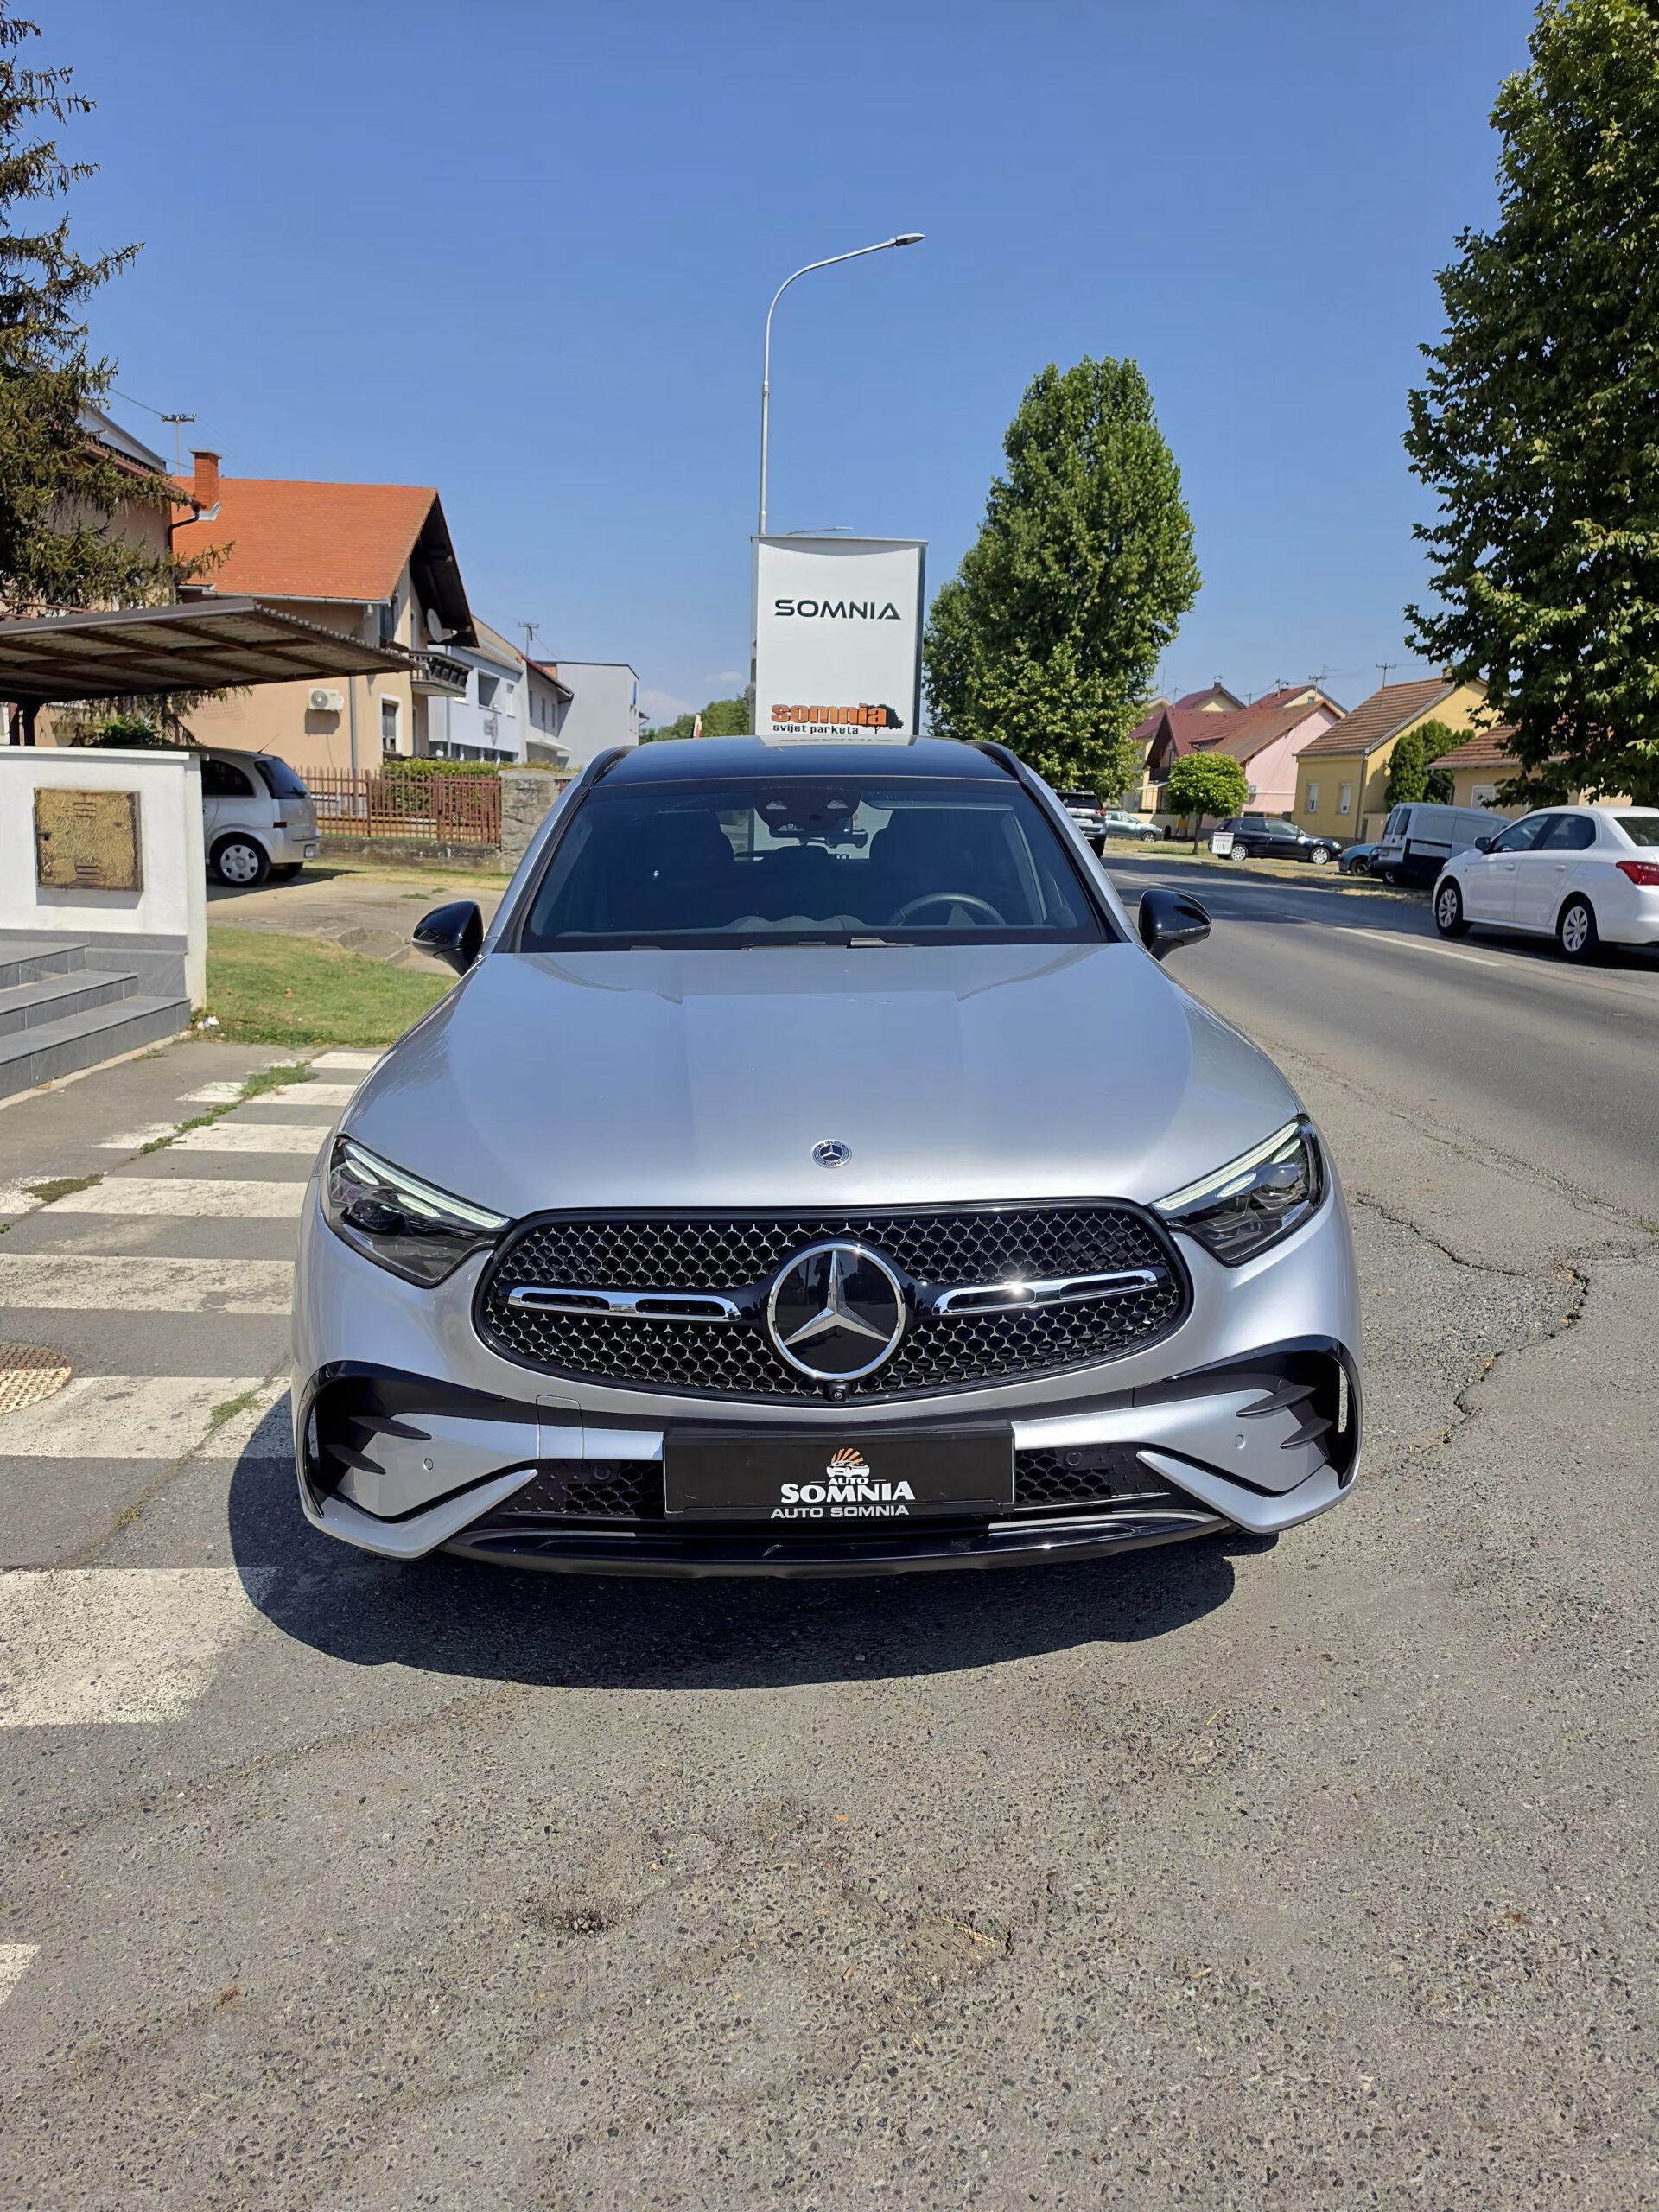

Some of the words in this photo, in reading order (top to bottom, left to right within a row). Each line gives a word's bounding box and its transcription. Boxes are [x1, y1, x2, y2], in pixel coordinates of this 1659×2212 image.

[774, 599, 901, 620] SOMNIA
[771, 703, 887, 726] somnia
[772, 724, 807, 734] svijet
[810, 725, 859, 734] parketa
[828, 1477, 869, 1485] AUTO
[780, 1480, 916, 1503] SOMNIA
[770, 1507, 824, 1519] AUTO
[830, 1504, 910, 1518] SOMNIA
